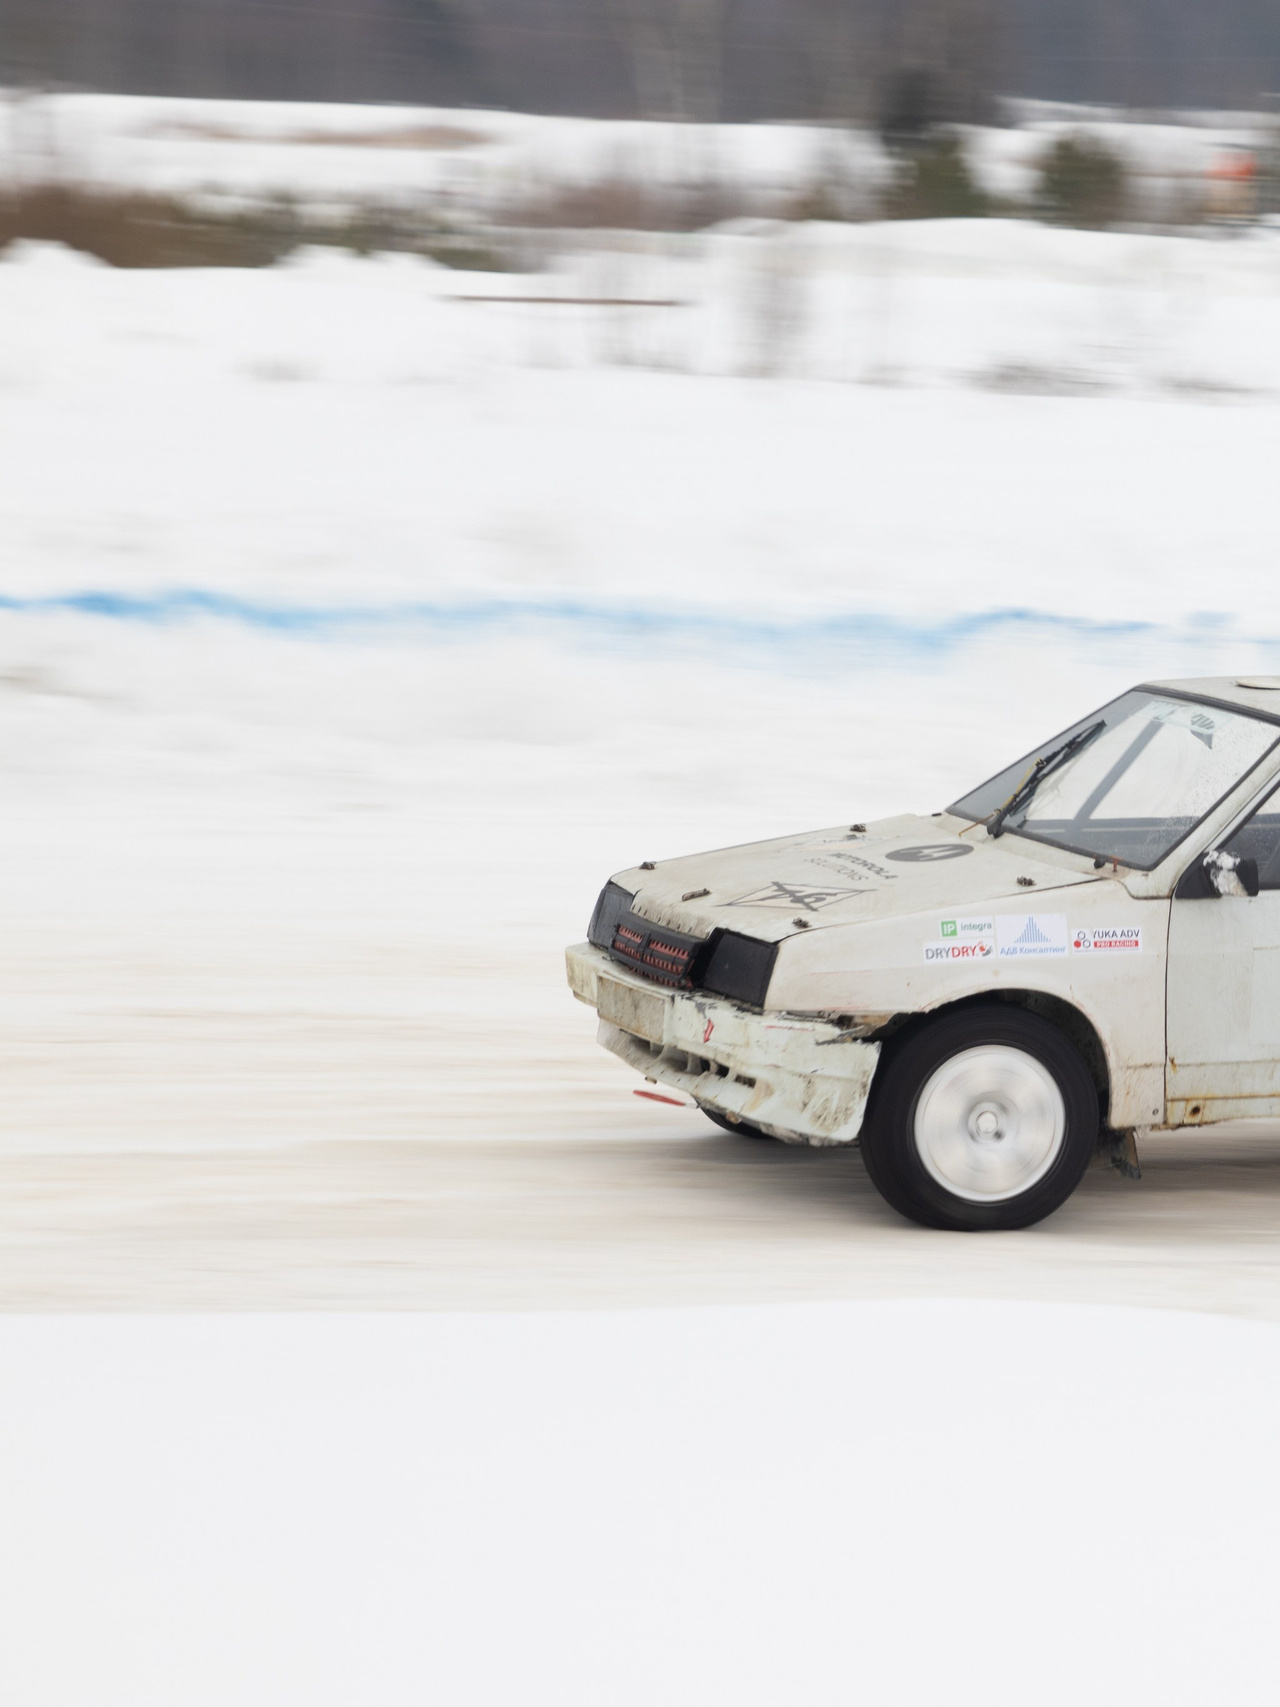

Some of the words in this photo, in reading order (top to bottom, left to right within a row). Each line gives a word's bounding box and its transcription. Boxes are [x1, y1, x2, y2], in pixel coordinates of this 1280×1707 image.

[960, 922, 992, 932] integra
[1119, 929, 1140, 938] ADV
[925, 945, 977, 960] DRYDRY
